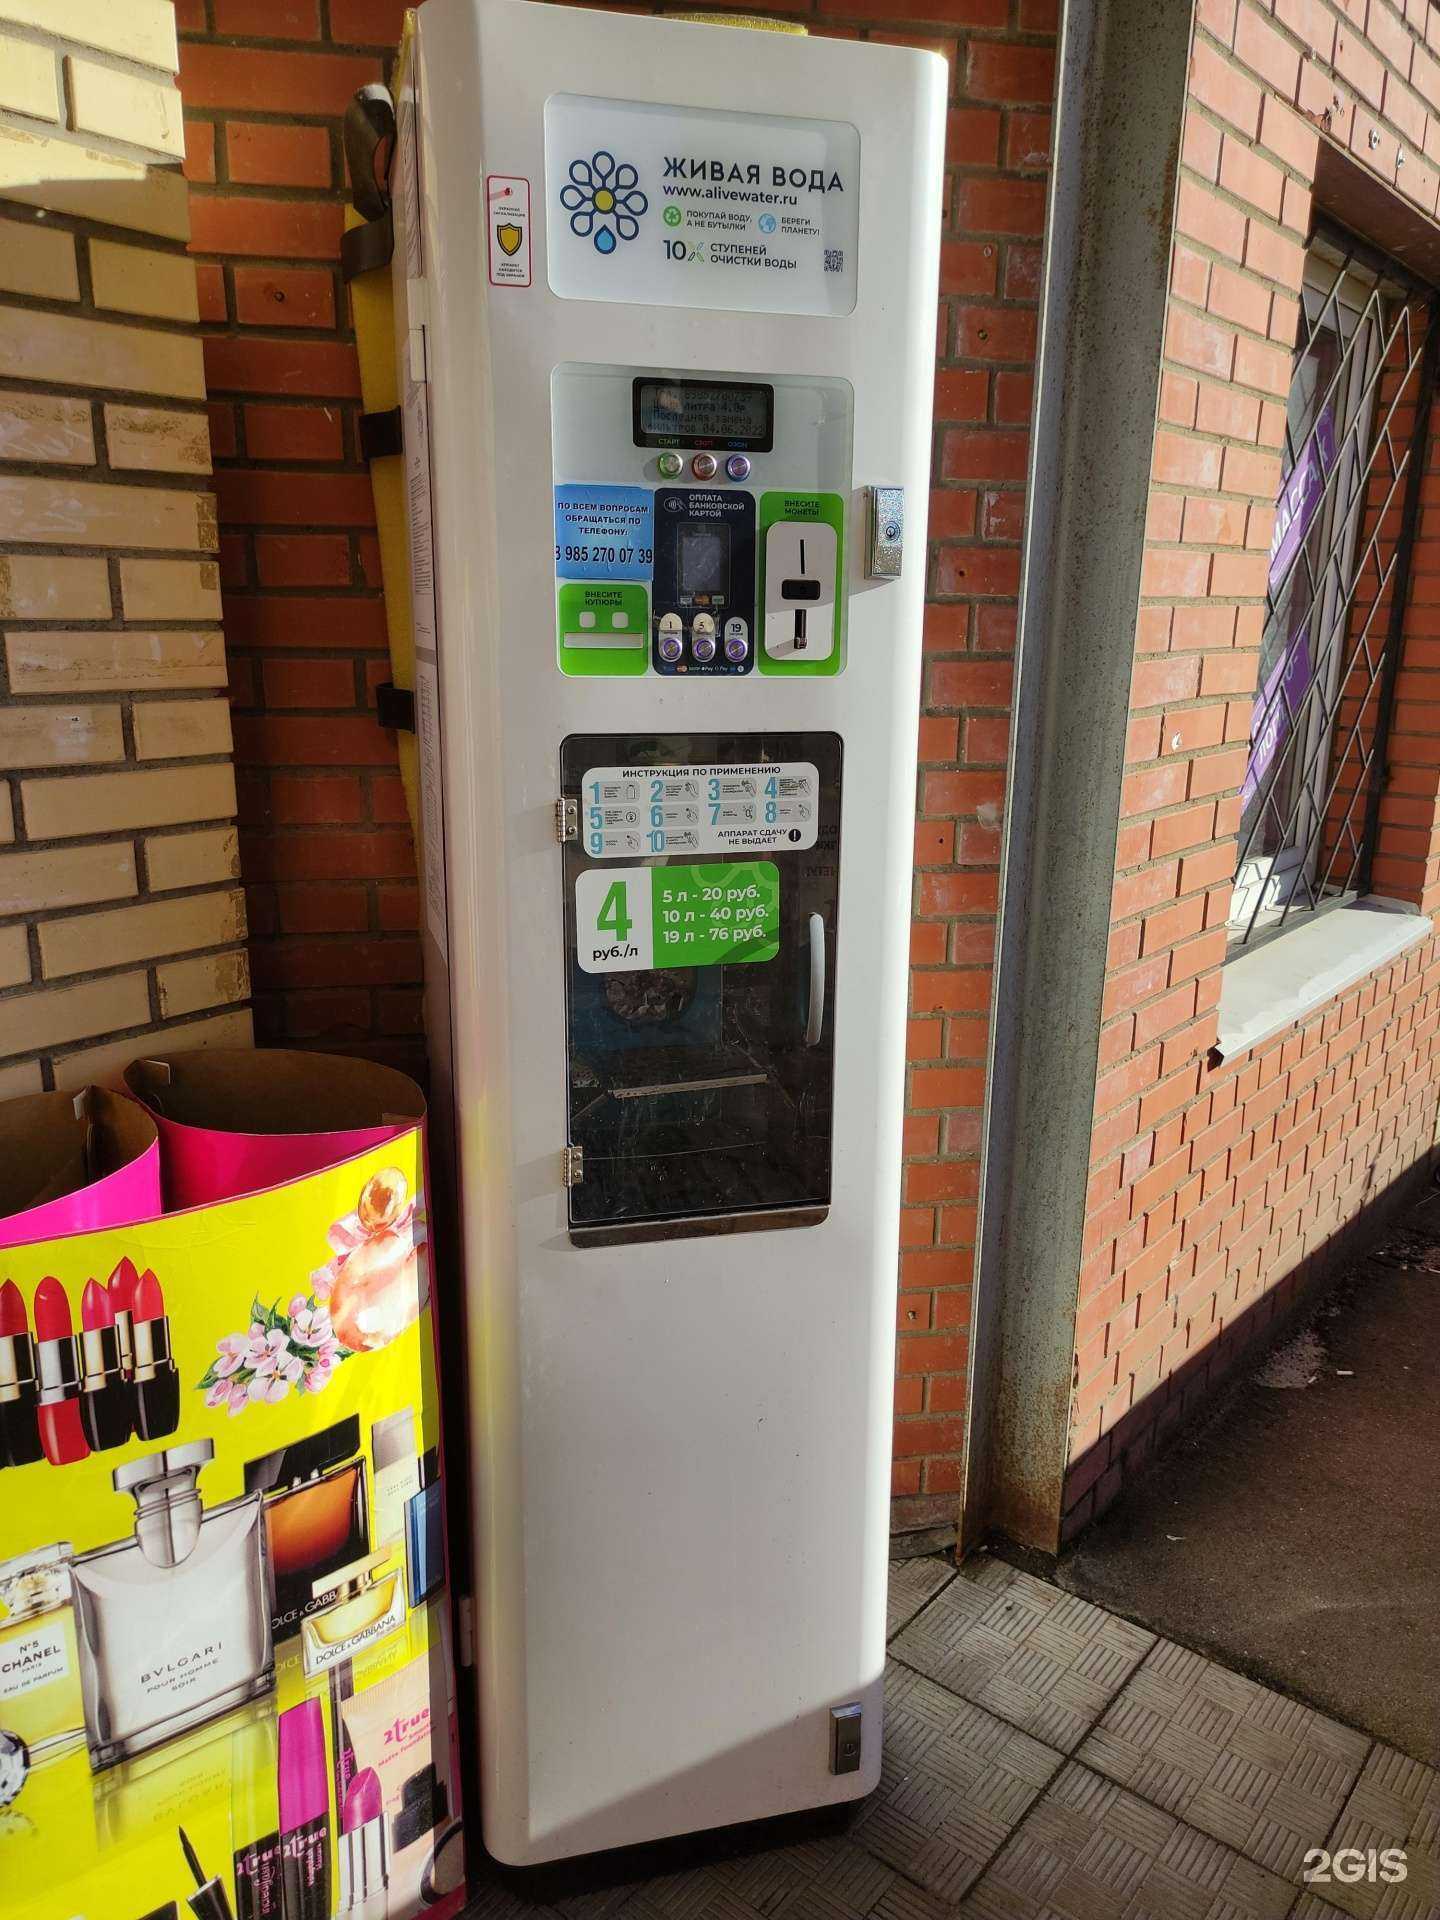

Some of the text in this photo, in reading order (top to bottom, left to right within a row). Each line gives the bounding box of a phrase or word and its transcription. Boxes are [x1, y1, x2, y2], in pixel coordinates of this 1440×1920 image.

[663, 157, 844, 194] ЖИВАЯ ВОДА
[663, 185, 797, 205] www.alivewater.ru
[687, 210, 726, 220] ПОКУПАЙ
[782, 217, 811, 226] БЕРЕГИ
[707, 222, 745, 231] БУТЫЛКИ
[782, 226, 820, 236] ПЛАНЕТУ!
[710, 243, 767, 256] СТУПЕНЕЙ
[710, 254, 797, 269] ОЧИСТКИ ВОДЫ
[658, 438, 680, 446] СТАРТ
[727, 441, 748, 449] ОЗОН
[558, 502, 570, 510] ПО
[573, 503, 597, 511] ВСЕМ
[689, 494, 723, 502] ОПЛАТА
[689, 501, 745, 511] БАНКОВСКОЙ
[784, 500, 820, 508] ВНЕСИТЕ
[565, 515, 641, 525] ОБРАЩАТЬСЯ ПО
[689, 509, 722, 518] КАРТОЙ
[784, 508, 820, 516] МОНЕТЫ
[565, 546, 589, 562] 985
[592, 546, 615, 563] 270
[620, 548, 634, 563] 07
[638, 549, 653, 564] 39
[585, 591, 623, 599] ВНЕСИТЕ
[585, 598, 623, 606] КУПЮРЫ
[731, 623, 742, 633] 19
[622, 766, 781, 778] ИНСТРУКЦИЯ ПО ПРИМЕНЕНИЮ
[589, 782, 600, 804] 1
[650, 780, 664, 803] 2
[708, 778, 720, 801] 3
[764, 776, 778, 799] 4
[590, 806, 603, 830] 5
[650, 805, 664, 828] 6
[708, 803, 721, 826] 7
[765, 801, 777, 824] 8
[646, 830, 665, 853] 10
[717, 828, 788, 838] АППАРАТ СДАЧУ
[741, 837, 777, 845] ВЫДАЕТ
[590, 832, 603, 855] 9
[663, 890, 673, 903] 5
[677, 890, 689, 902] л
[702, 887, 723, 901] 20
[727, 884, 761, 902] руб.
[597, 881, 633, 942] 4
[662, 909, 681, 924] 10
[684, 910, 695, 922] л
[709, 907, 732, 920] 40
[736, 904, 769, 922] руб.
[662, 930, 680, 944] 19
[683, 931, 695, 943] л
[708, 927, 729, 941] 76
[733, 924, 767, 942] руб.
[592, 944, 639, 961] руб./л
[315, 1645, 346, 1665] DOLCE
[351, 1615, 396, 1646] GABBANA
[2, 1645, 61, 1673] CHANEL
[140, 1641, 222, 1684] BVLGARI
[384, 1708, 430, 1745] 2true
[283, 1827, 327, 1858] 2true
